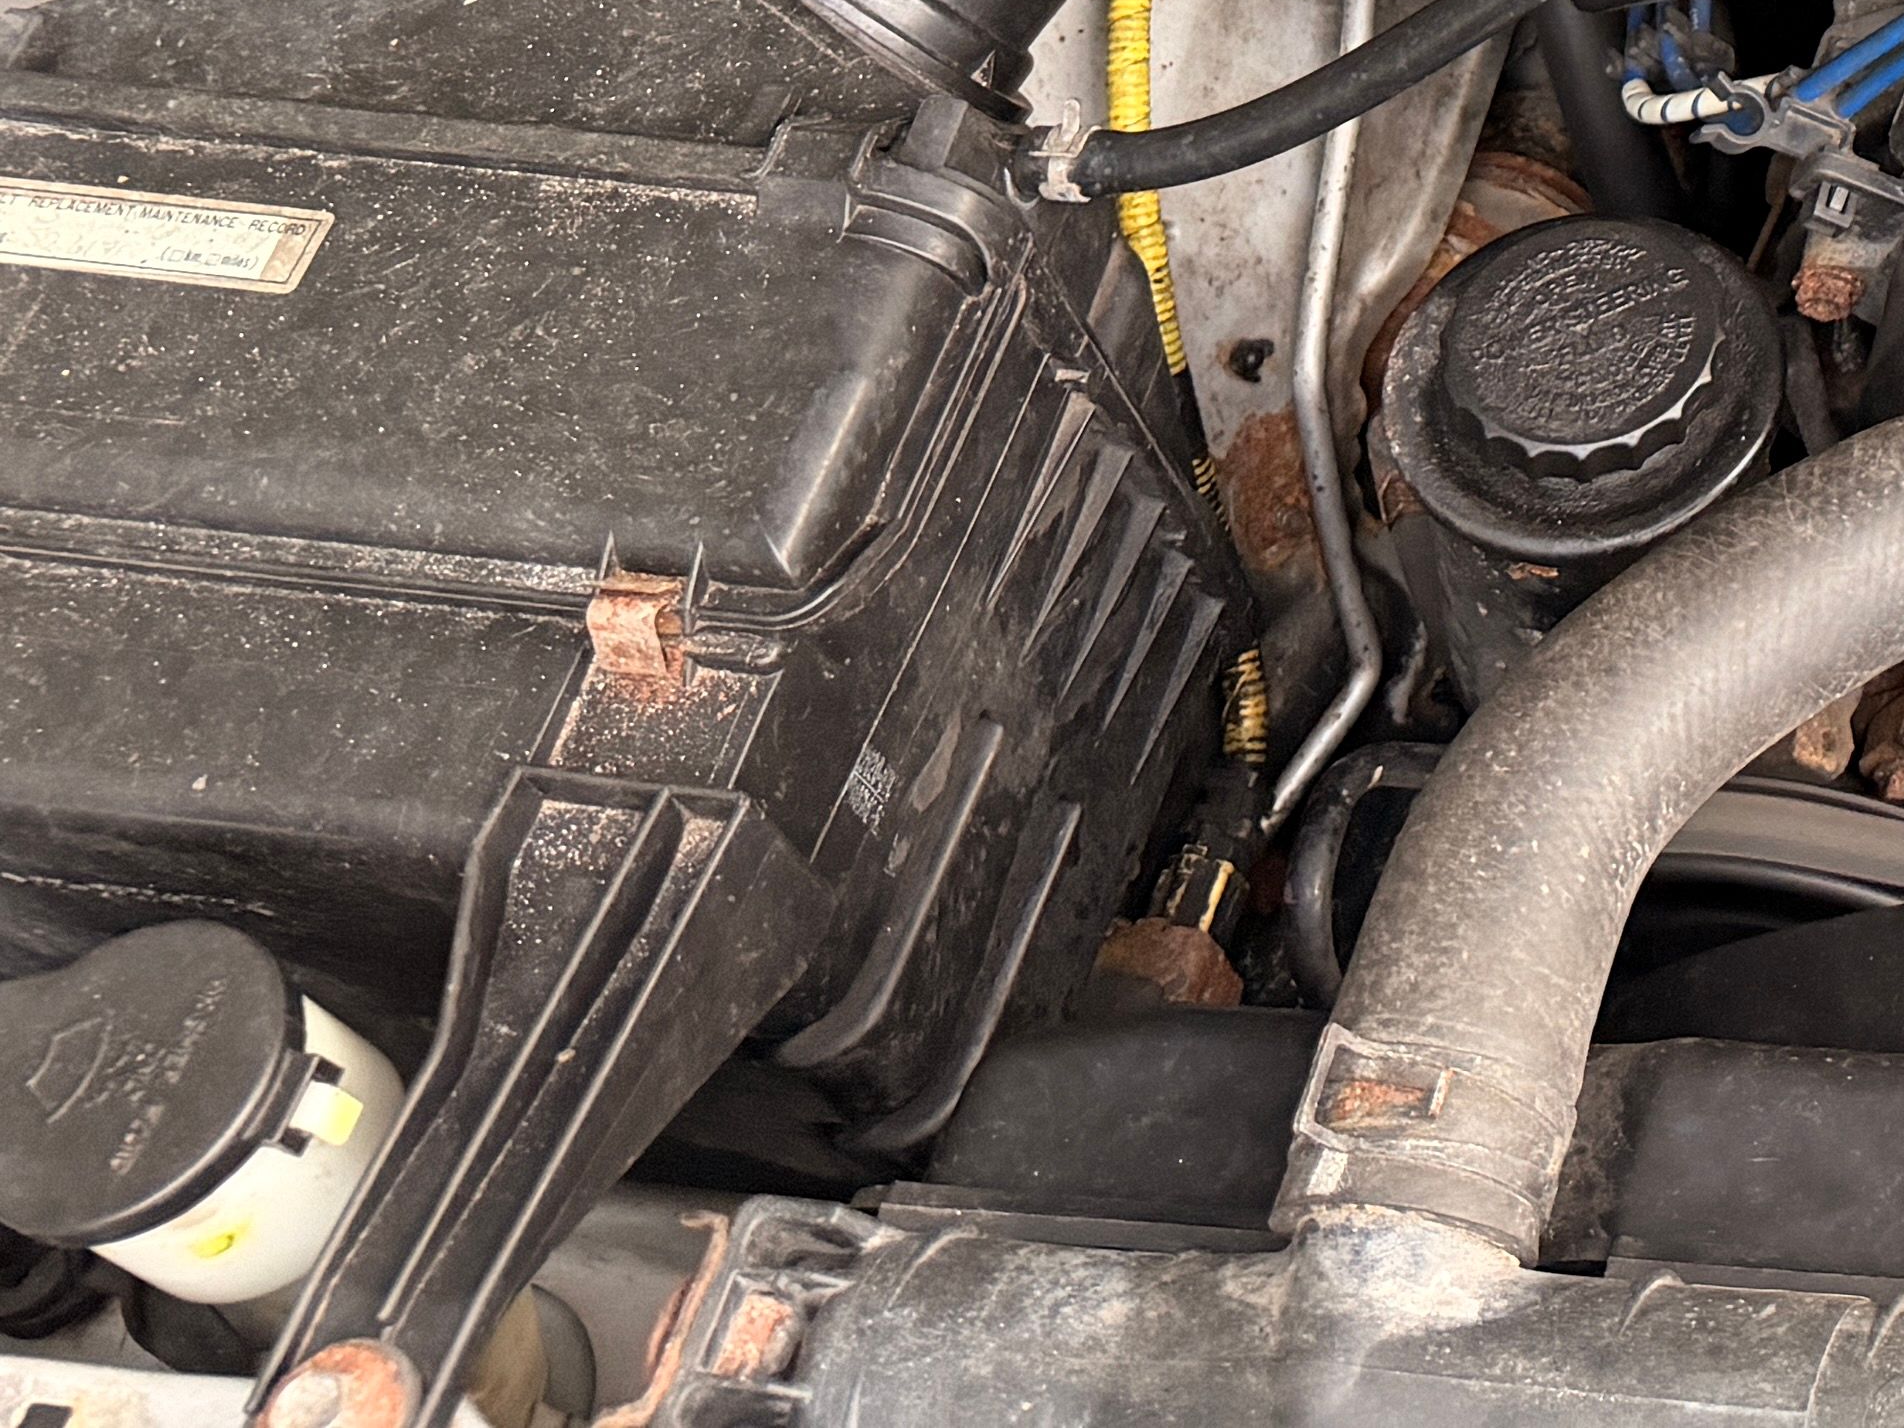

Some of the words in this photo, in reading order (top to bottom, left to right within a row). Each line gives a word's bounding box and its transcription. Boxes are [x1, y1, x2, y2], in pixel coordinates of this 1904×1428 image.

[28, 195, 133, 217] REPLACEMENT
[139, 206, 237, 229] MAINTENANCE
[248, 219, 306, 236] RECORD
